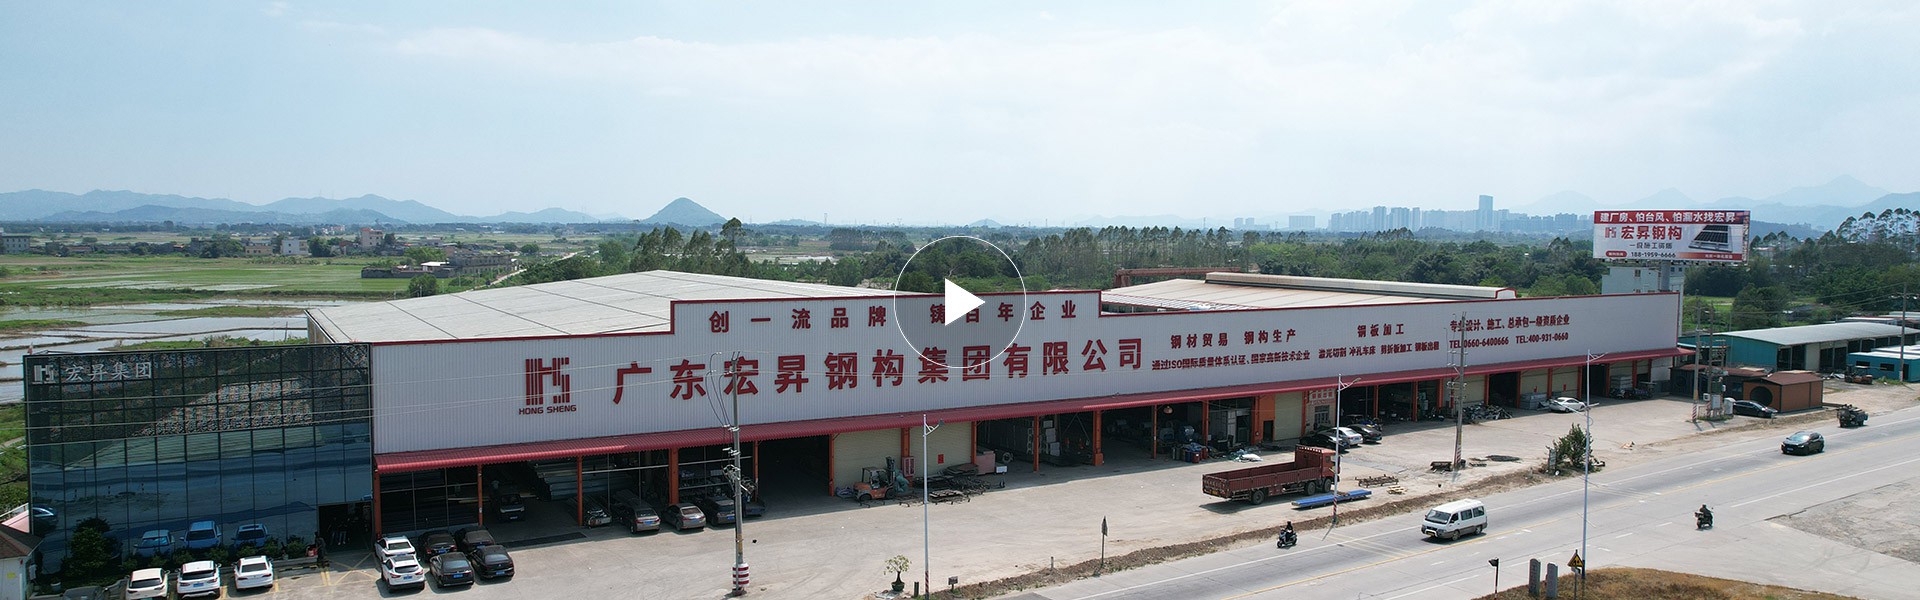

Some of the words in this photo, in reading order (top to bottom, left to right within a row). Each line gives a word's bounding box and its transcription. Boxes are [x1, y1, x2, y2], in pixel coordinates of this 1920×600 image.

[1600, 212, 1736, 223] 建厂房、怕台风、怕漏水找宏昇
[1621, 226, 1682, 240] 宏昇钢构
[708, 305, 887, 334] 创一流品牌
[1170, 332, 1228, 349] 钢材贸易
[1244, 328, 1297, 345] 钢构生产
[1357, 323, 1404, 337] 钢板加工
[1450, 336, 1509, 349] TEL0660-6400666
[1516, 332, 1569, 344] TEL:400-931-0660
[64, 361, 152, 381] 宏昇集团
[613, 337, 1143, 405] 广东宏昇钢构集团有限公司
[518, 406, 543, 415] HONG
[547, 404, 577, 414] SHENG
